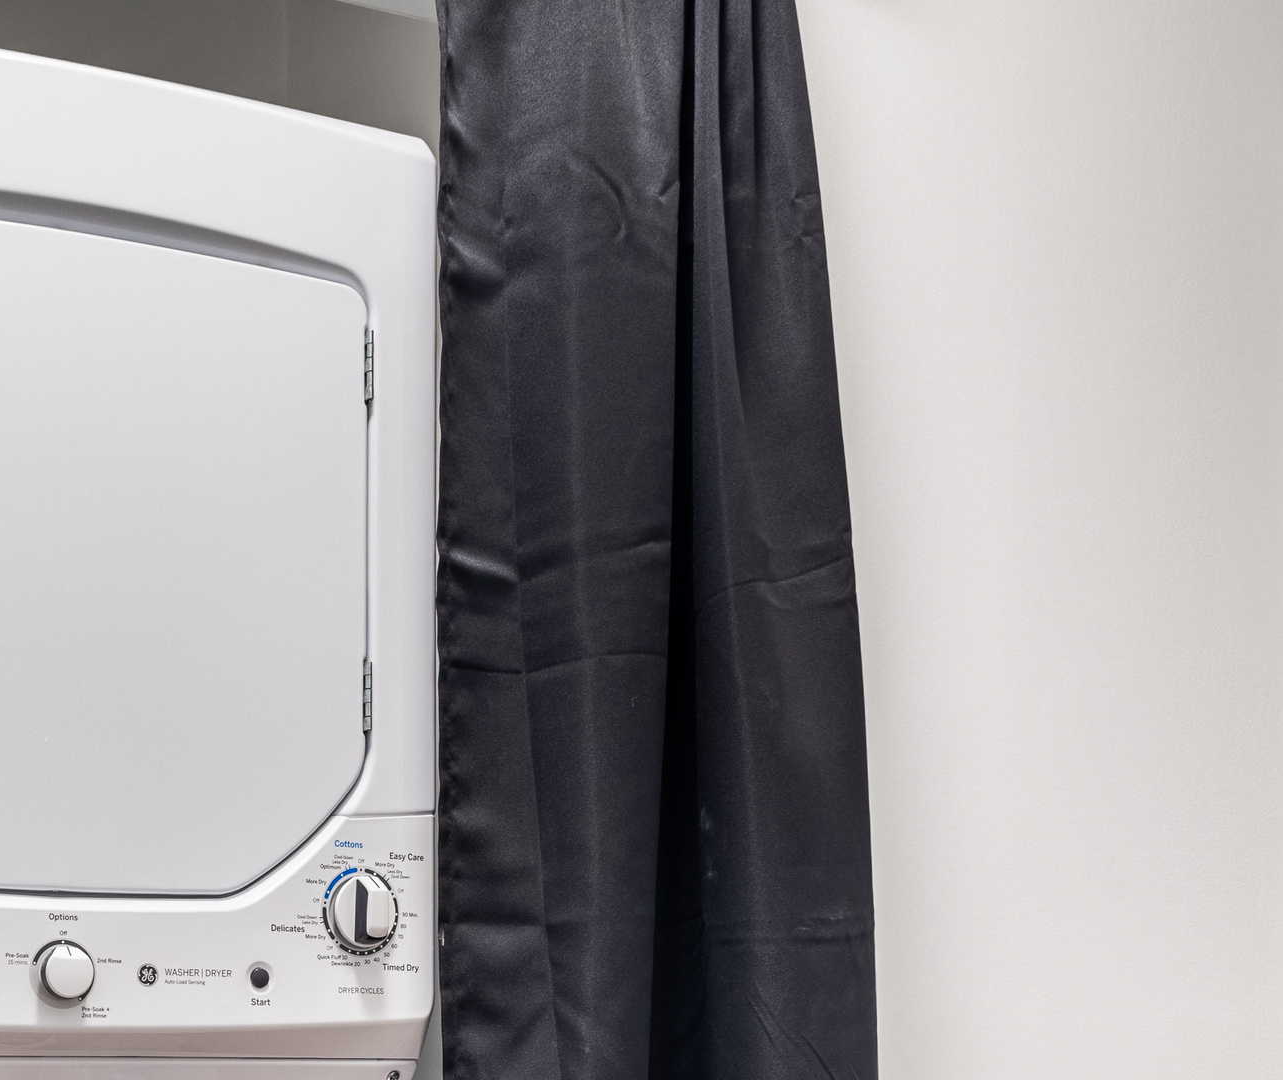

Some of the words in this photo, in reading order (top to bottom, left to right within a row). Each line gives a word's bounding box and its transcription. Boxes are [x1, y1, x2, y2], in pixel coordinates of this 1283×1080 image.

[334, 840, 363, 849] Cottons
[389, 852, 405, 861] Easy
[408, 853, 424, 861] Care
[48, 913, 78, 922] Options
[271, 924, 305, 933] Delicates
[165, 968, 200, 976] WASHER
[205, 969, 232, 977] DRYER
[382, 963, 405, 972] Timed
[406, 964, 419, 973] Dry
[251, 998, 271, 1006] Start
